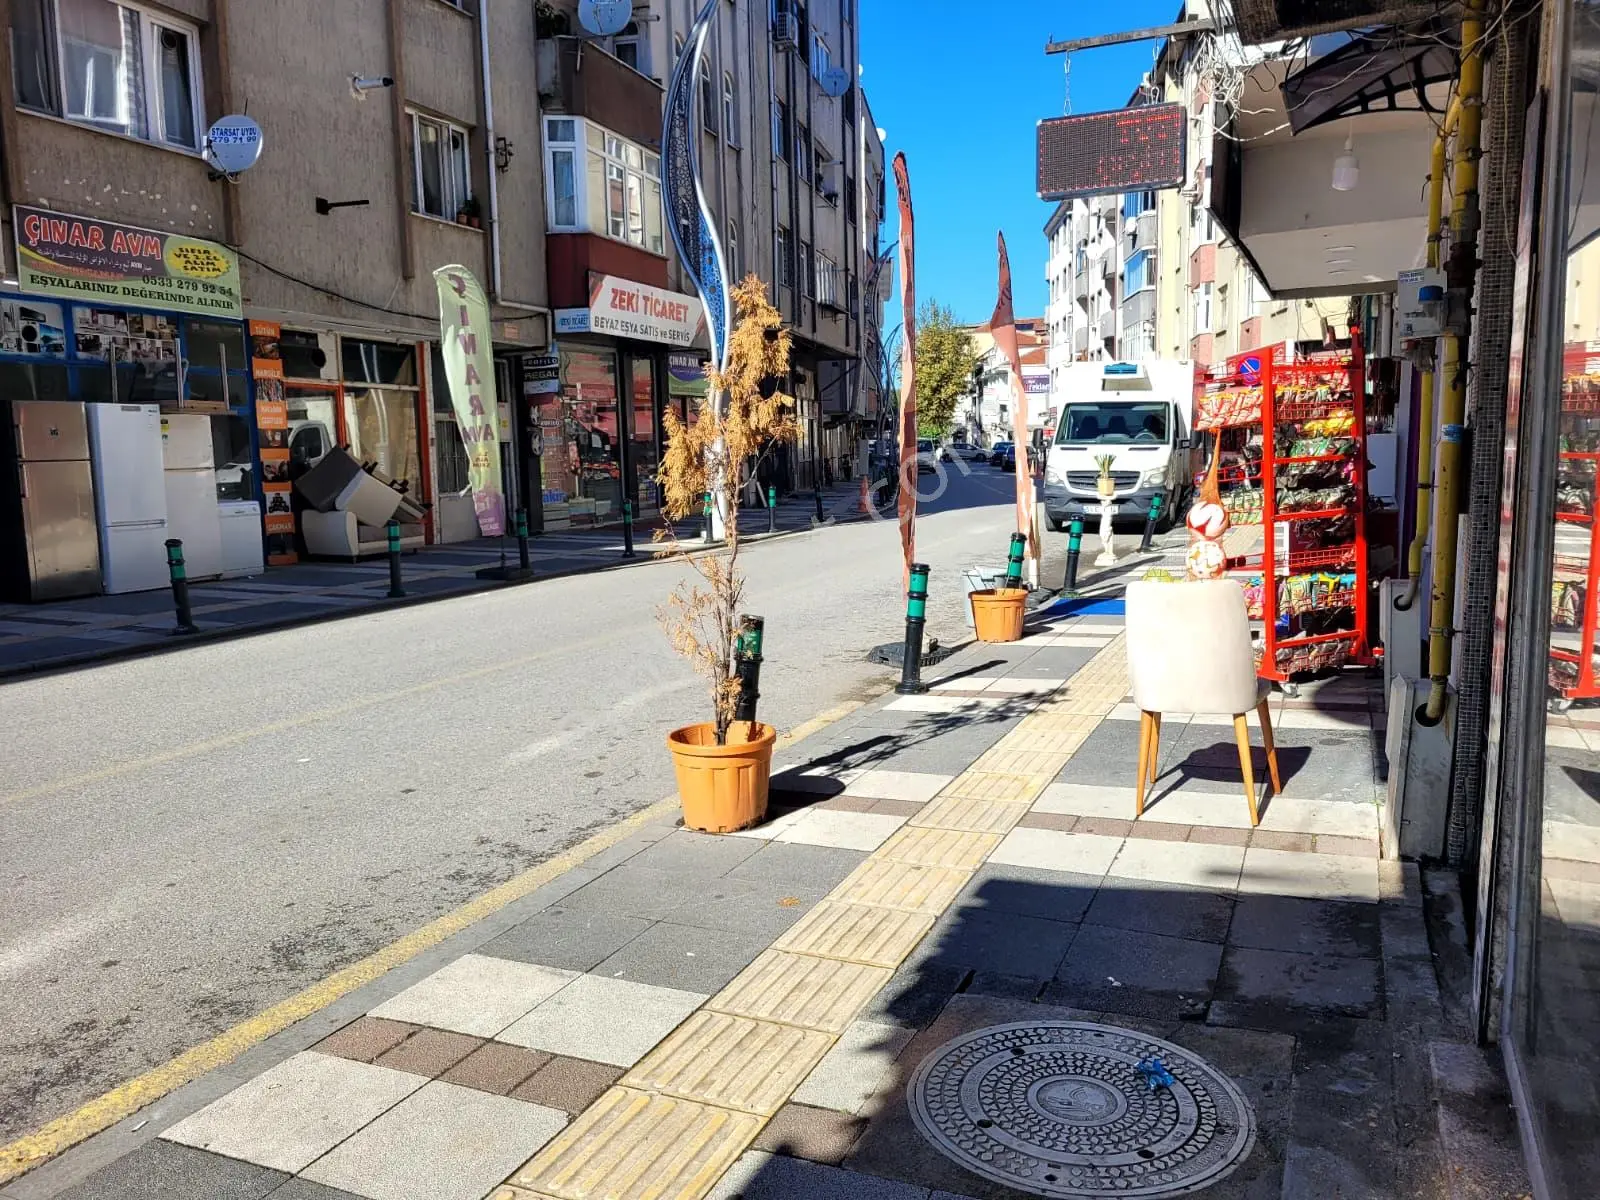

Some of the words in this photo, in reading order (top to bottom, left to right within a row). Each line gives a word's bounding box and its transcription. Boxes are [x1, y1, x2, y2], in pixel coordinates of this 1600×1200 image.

[211, 127, 240, 137] STARSAT
[211, 136, 230, 144] 279
[24, 214, 106, 252] ÇINAR
[111, 230, 162, 260] AVM
[30, 274, 119, 295] EŞYALARINIZ
[122, 285, 194, 305] DEĞERİNDE
[196, 296, 234, 310] ALINIR
[142, 275, 172, 288] 0533
[177, 279, 198, 292] 279
[202, 283, 216, 294] 92
[218, 286, 233, 297] 54
[610, 288, 640, 314] ZEKİ
[642, 292, 689, 323] TİCARET
[594, 315, 619, 330] BEYAZ
[620, 320, 638, 336] EŞYA
[639, 324, 659, 341] SATIŞ
[659, 330, 667, 339] ve
[668, 329, 690, 342] SERVİS
[524, 370, 559, 379] REGAL
